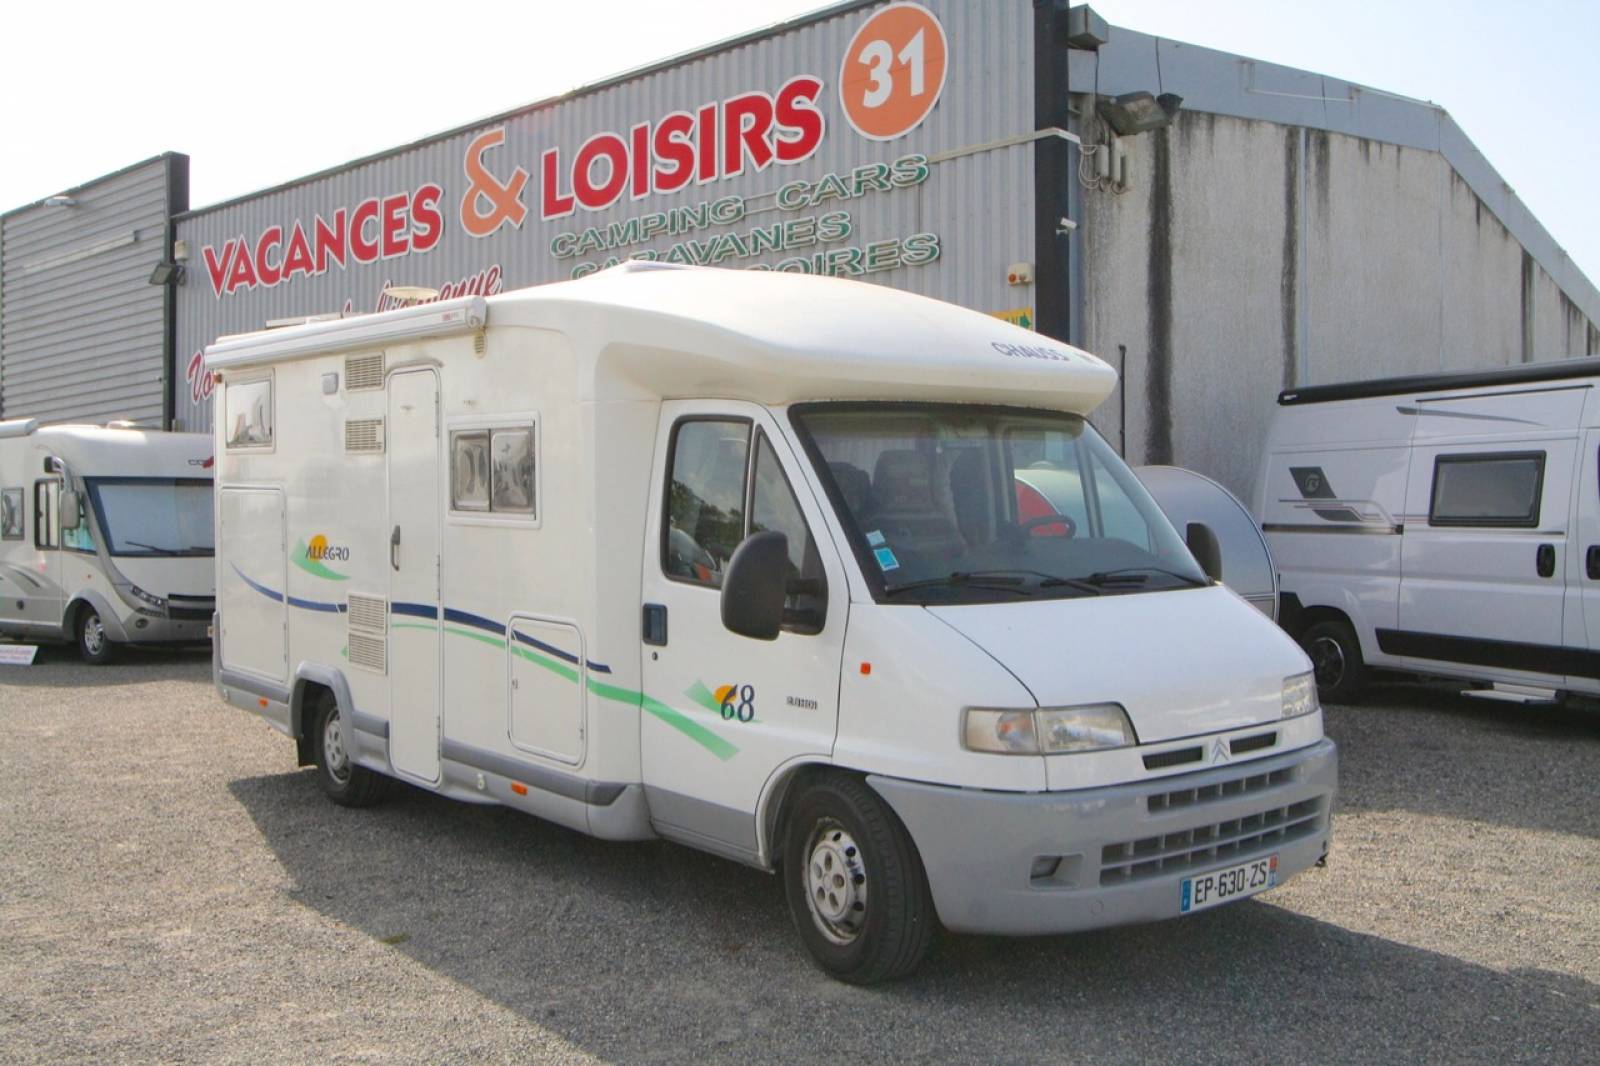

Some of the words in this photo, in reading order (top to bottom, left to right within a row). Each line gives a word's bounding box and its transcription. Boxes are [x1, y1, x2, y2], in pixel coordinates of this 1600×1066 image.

[856, 27, 925, 109] 31
[202, 183, 443, 299] VACANCES
[460, 126, 529, 238] &
[541, 74, 824, 220] LOISIRS
[550, 199, 746, 260] CAMPING
[776, 153, 930, 211] CARS
[990, 341, 1096, 364] CHAUSS
[304, 545, 350, 561] ALLEGRO
[720, 684, 755, 722] 68
